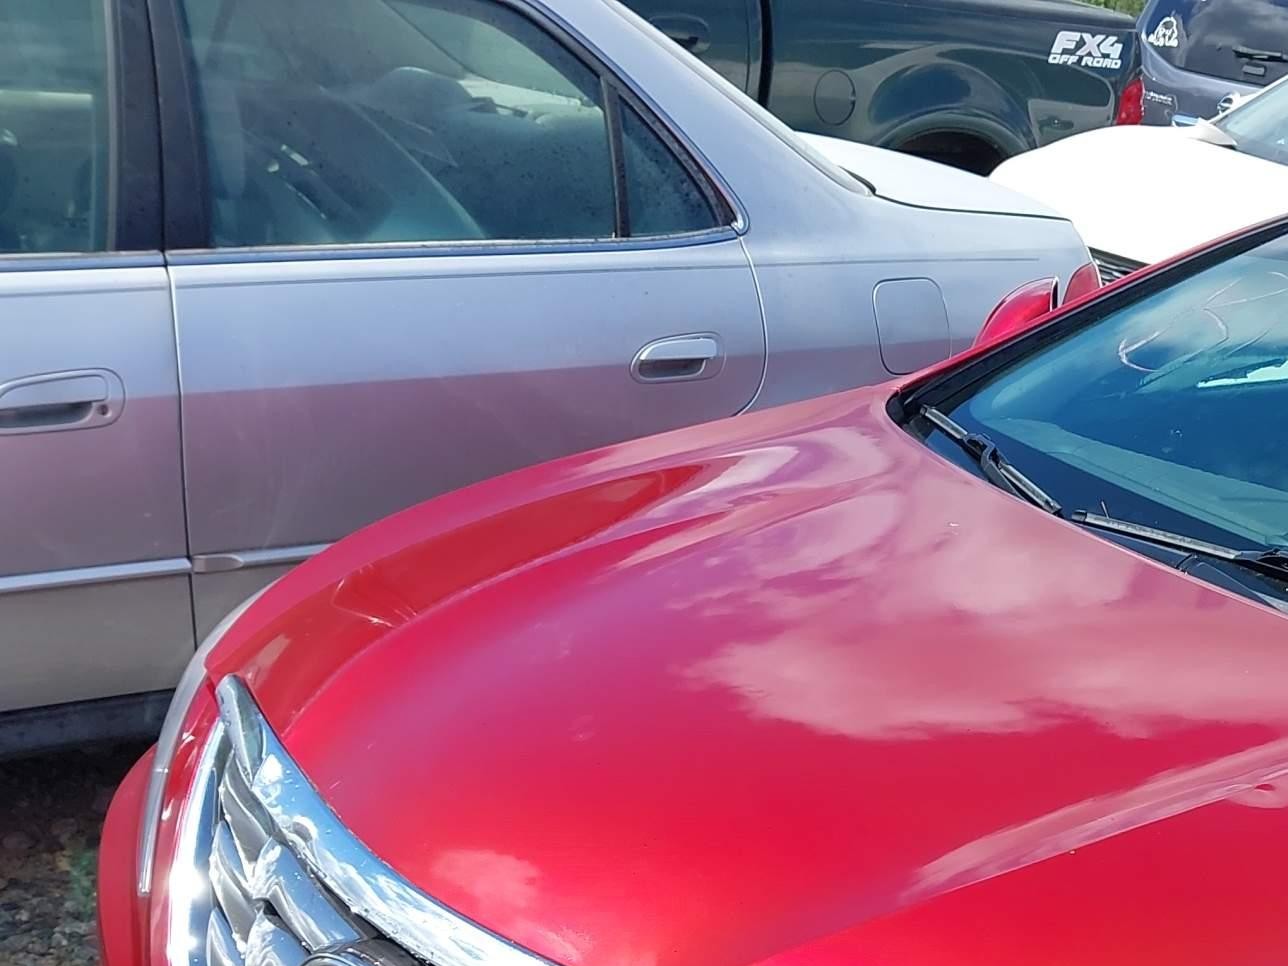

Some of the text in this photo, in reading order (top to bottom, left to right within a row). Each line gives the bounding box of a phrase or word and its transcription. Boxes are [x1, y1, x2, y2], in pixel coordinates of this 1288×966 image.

[1051, 31, 1123, 58] FX4
[1048, 55, 1122, 69] OFF ROAD
